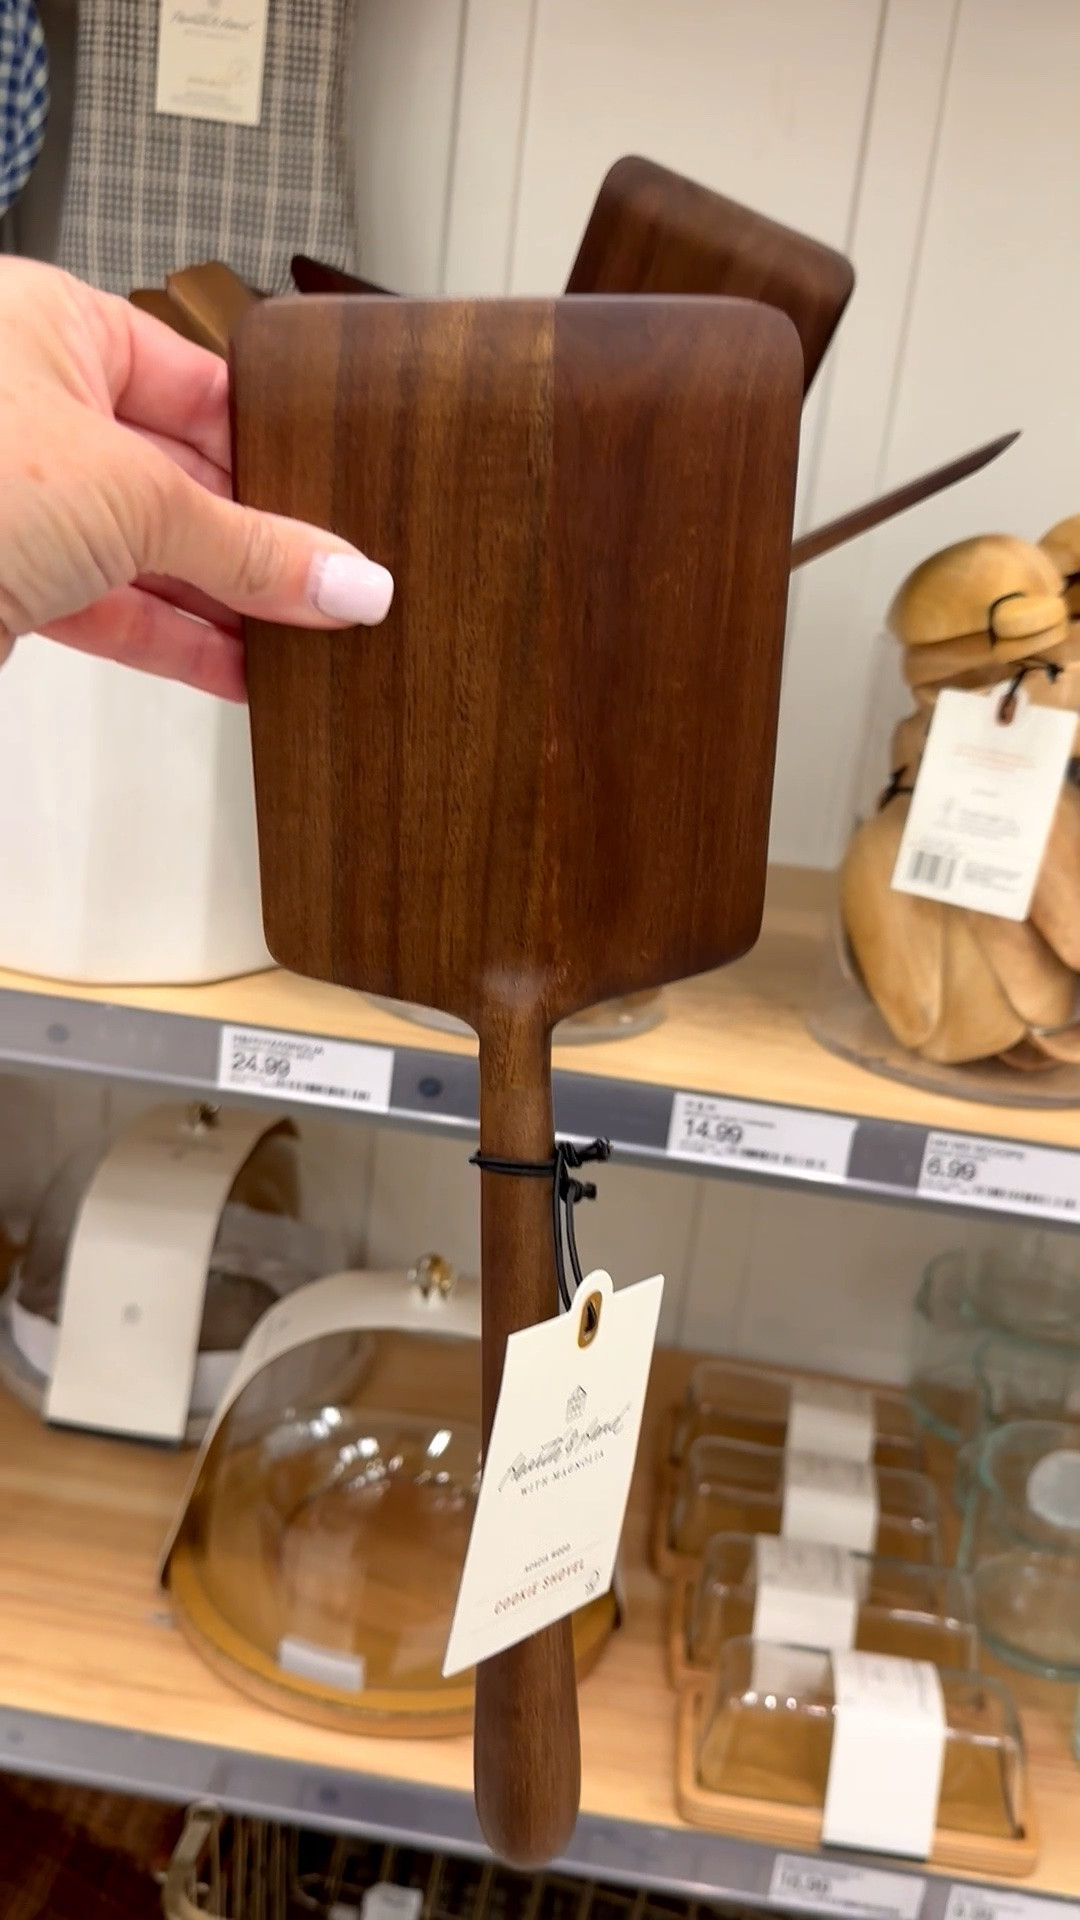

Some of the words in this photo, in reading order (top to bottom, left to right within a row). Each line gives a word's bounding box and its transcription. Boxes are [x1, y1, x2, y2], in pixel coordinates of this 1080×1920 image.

[231, 1051, 291, 1079] 24.99
[685, 1118, 744, 1145] 14.99
[926, 1155, 977, 1181] 6.99
[552, 1449, 604, 1482] MAGNOLIA
[494, 1580, 540, 1615] COOKIE
[542, 1558, 584, 1590] SHOVEL
